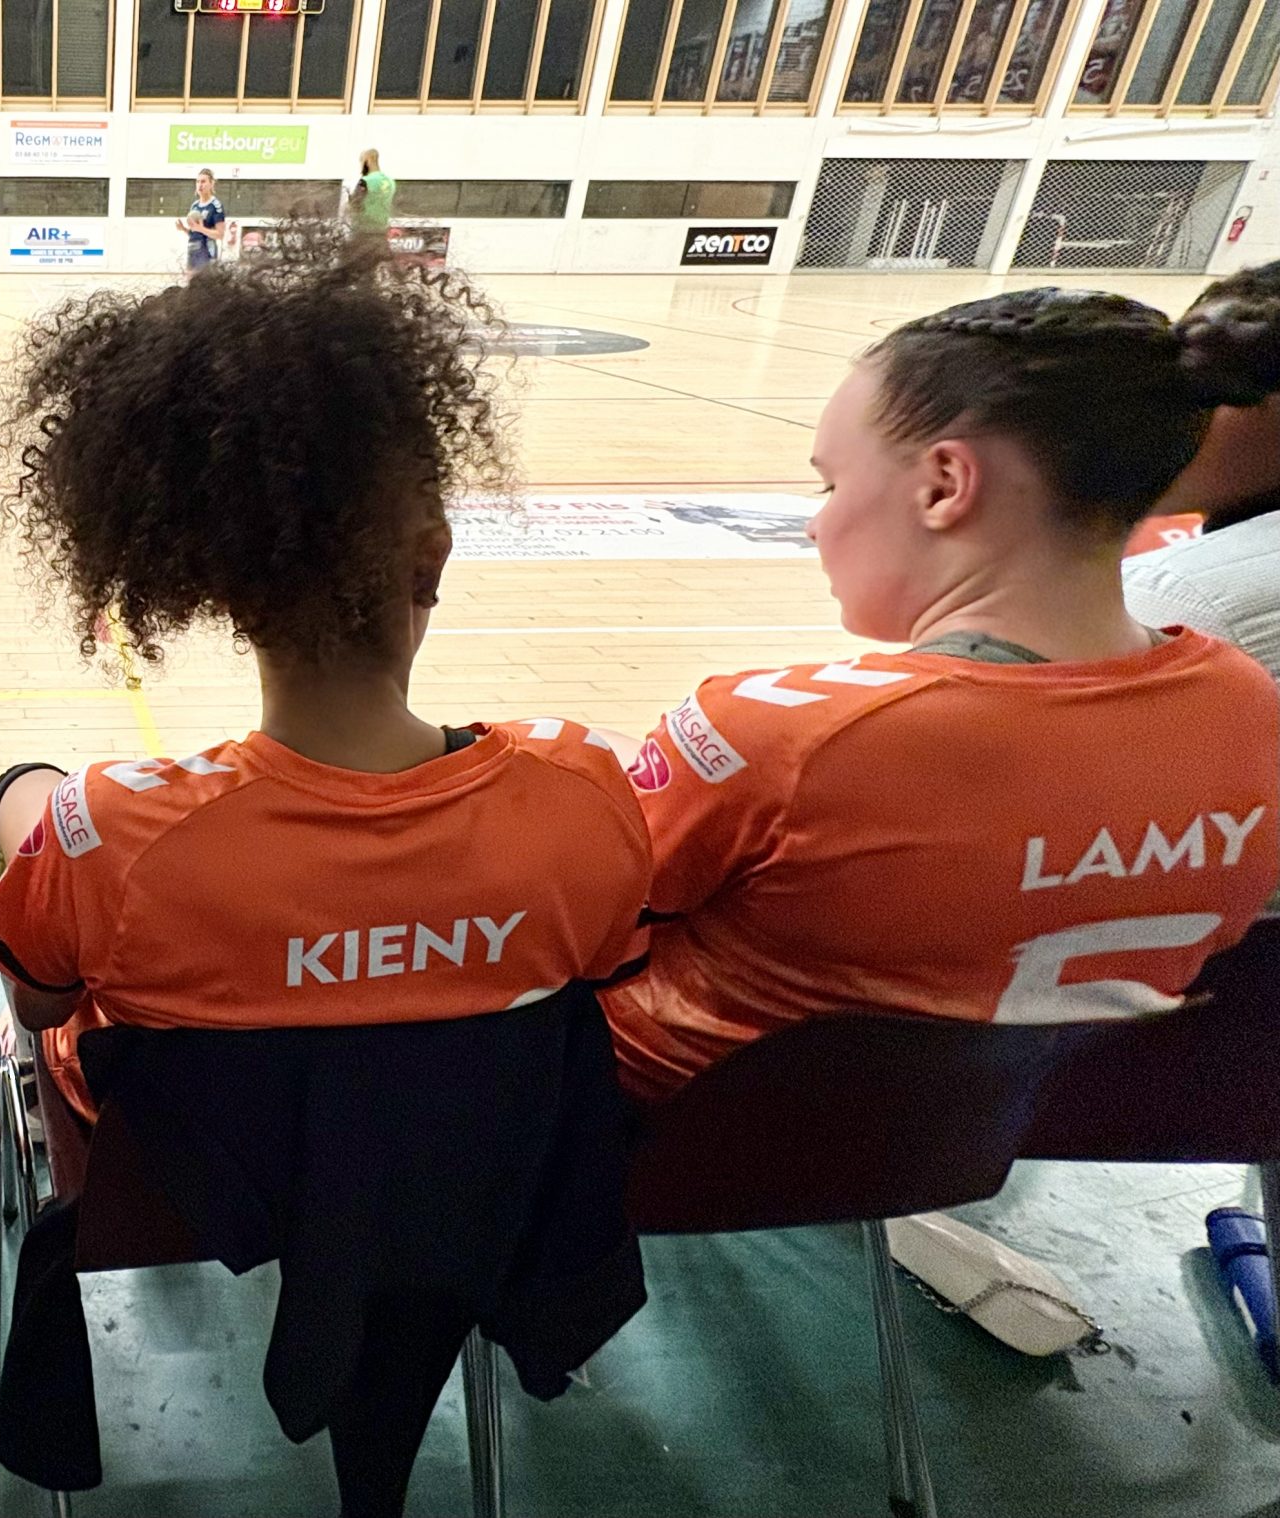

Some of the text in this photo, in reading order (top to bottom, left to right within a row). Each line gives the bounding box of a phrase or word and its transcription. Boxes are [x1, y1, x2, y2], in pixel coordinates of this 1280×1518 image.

[687, 234, 770, 253] RENTCO
[677, 707, 732, 772] ALSACE
[1020, 806, 1266, 892] LAMY
[285, 909, 528, 988] KIENY
